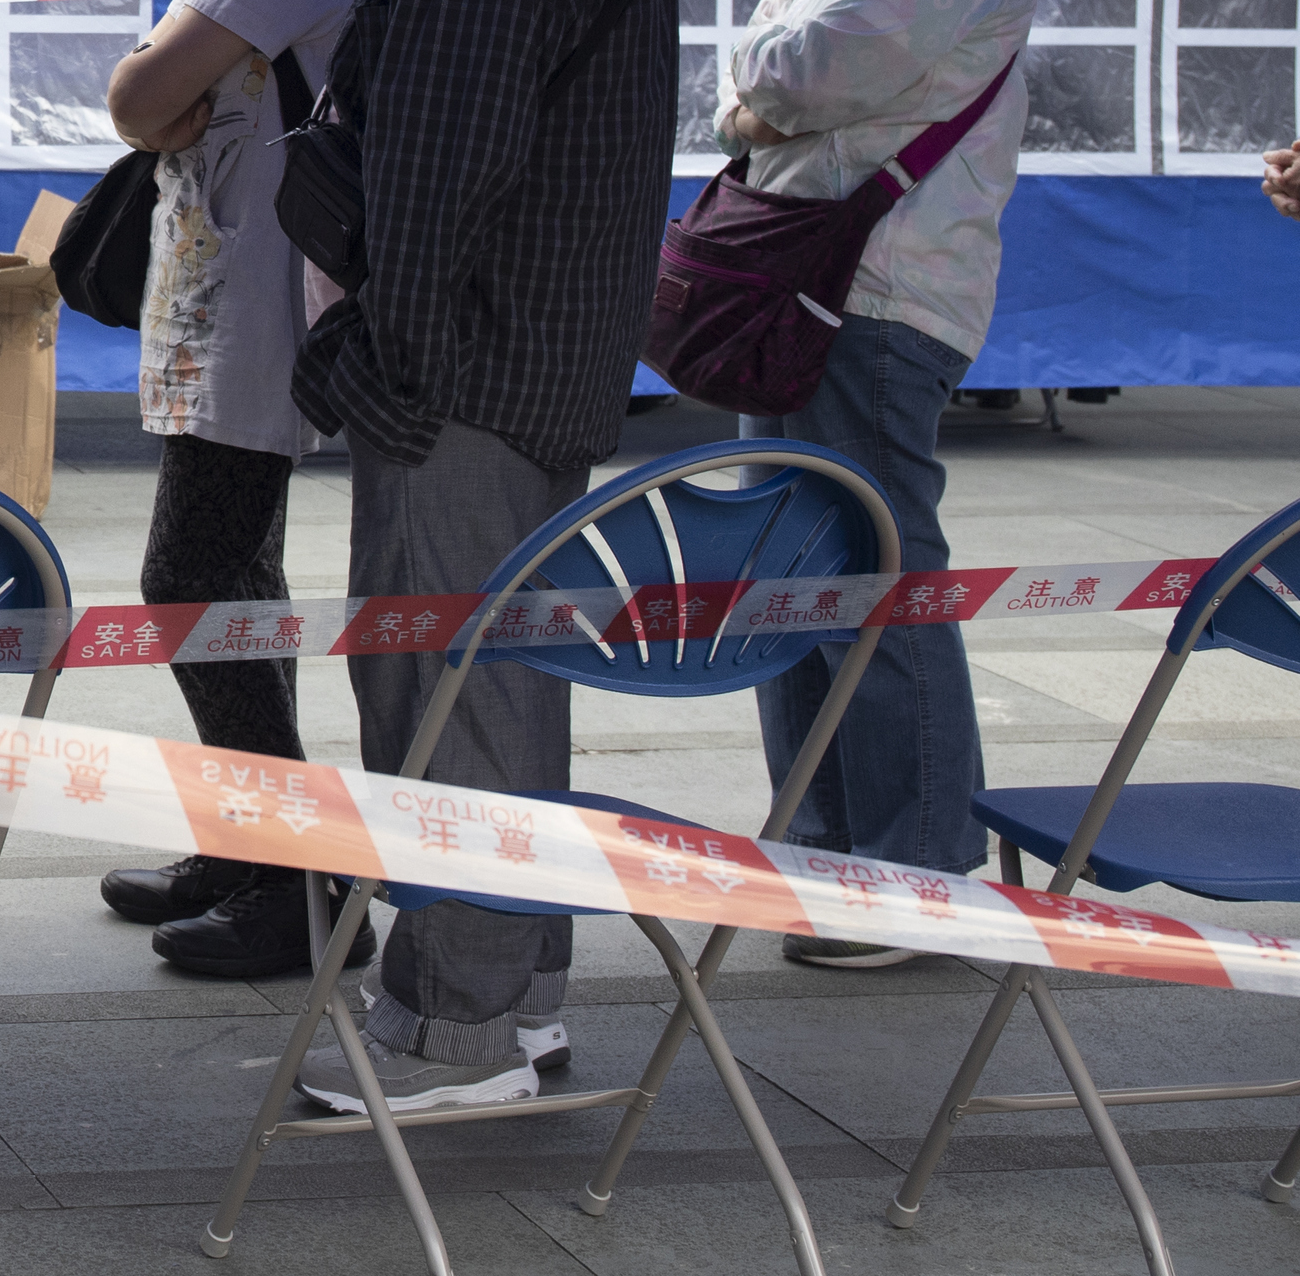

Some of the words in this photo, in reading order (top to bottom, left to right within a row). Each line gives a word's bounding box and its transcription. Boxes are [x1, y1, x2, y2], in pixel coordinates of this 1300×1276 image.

[906, 582, 970, 604] 安全
[1026, 577, 1100, 598] 注意
[644, 597, 708, 618] 安全
[766, 589, 842, 611] 注意
[1007, 595, 1095, 611] CAUTION
[500, 603, 578, 625] 注意
[748, 610, 838, 626] CAUTION
[891, 603, 956, 618] SAFE
[226, 615, 304, 639] 注意
[374, 610, 440, 632] 安全
[631, 617, 695, 632] SAFE
[95, 620, 162, 644] 安全
[360, 630, 426, 645] SAFE
[481, 624, 574, 640] CAUTION
[81, 643, 150, 659] SAFE
[207, 636, 302, 653] CAUTION
